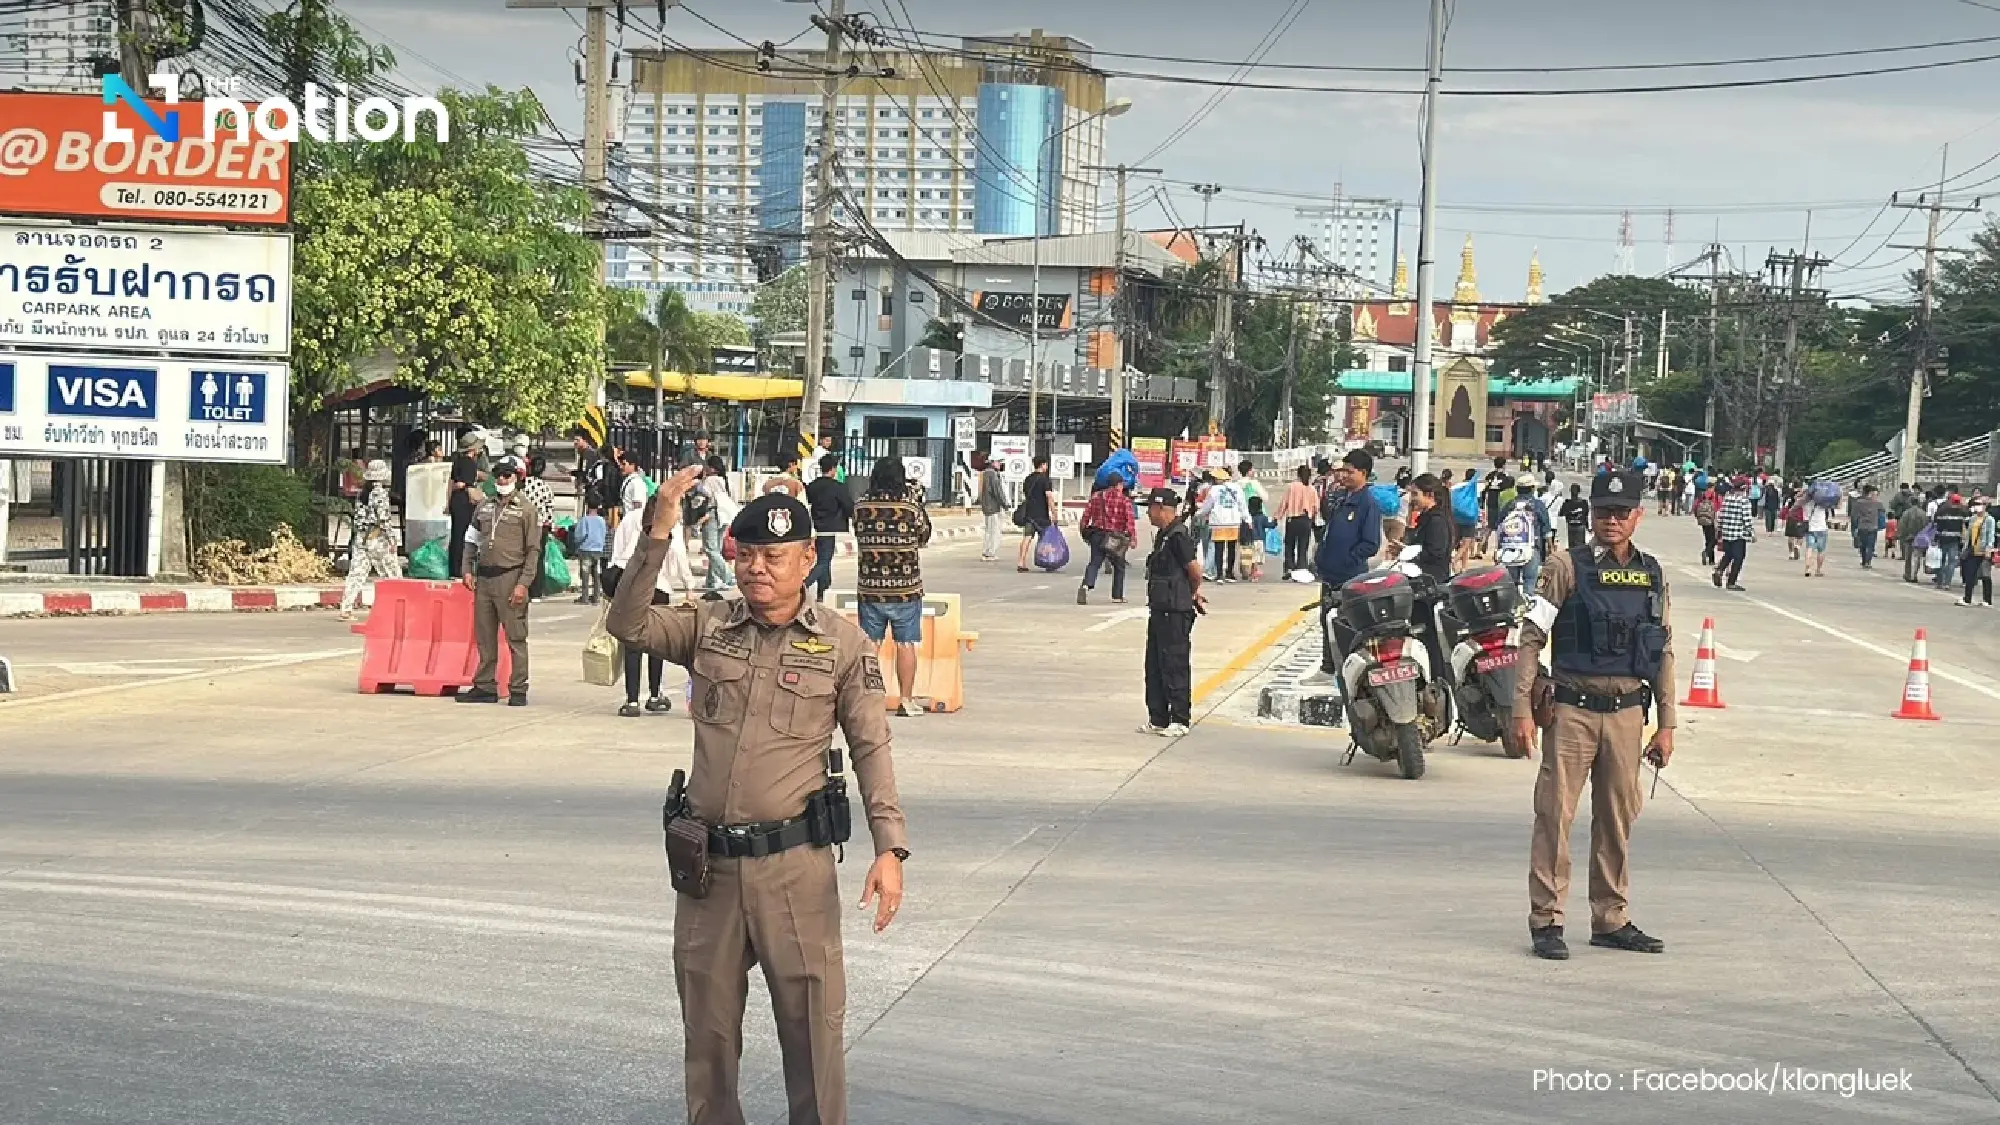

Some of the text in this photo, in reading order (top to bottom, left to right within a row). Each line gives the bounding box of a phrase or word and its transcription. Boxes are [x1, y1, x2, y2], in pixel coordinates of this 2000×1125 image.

[54, 131, 286, 180] BORDER
[116, 188, 268, 209] Tel. 080-5542121
[15, 231, 164, 250] ลานจอดรถ 2
[22, 301, 152, 320] CARPARK AREA
[197, 330, 215, 343] 24
[56, 376, 149, 409] VISA
[1602, 571, 1649, 585] POLICE
